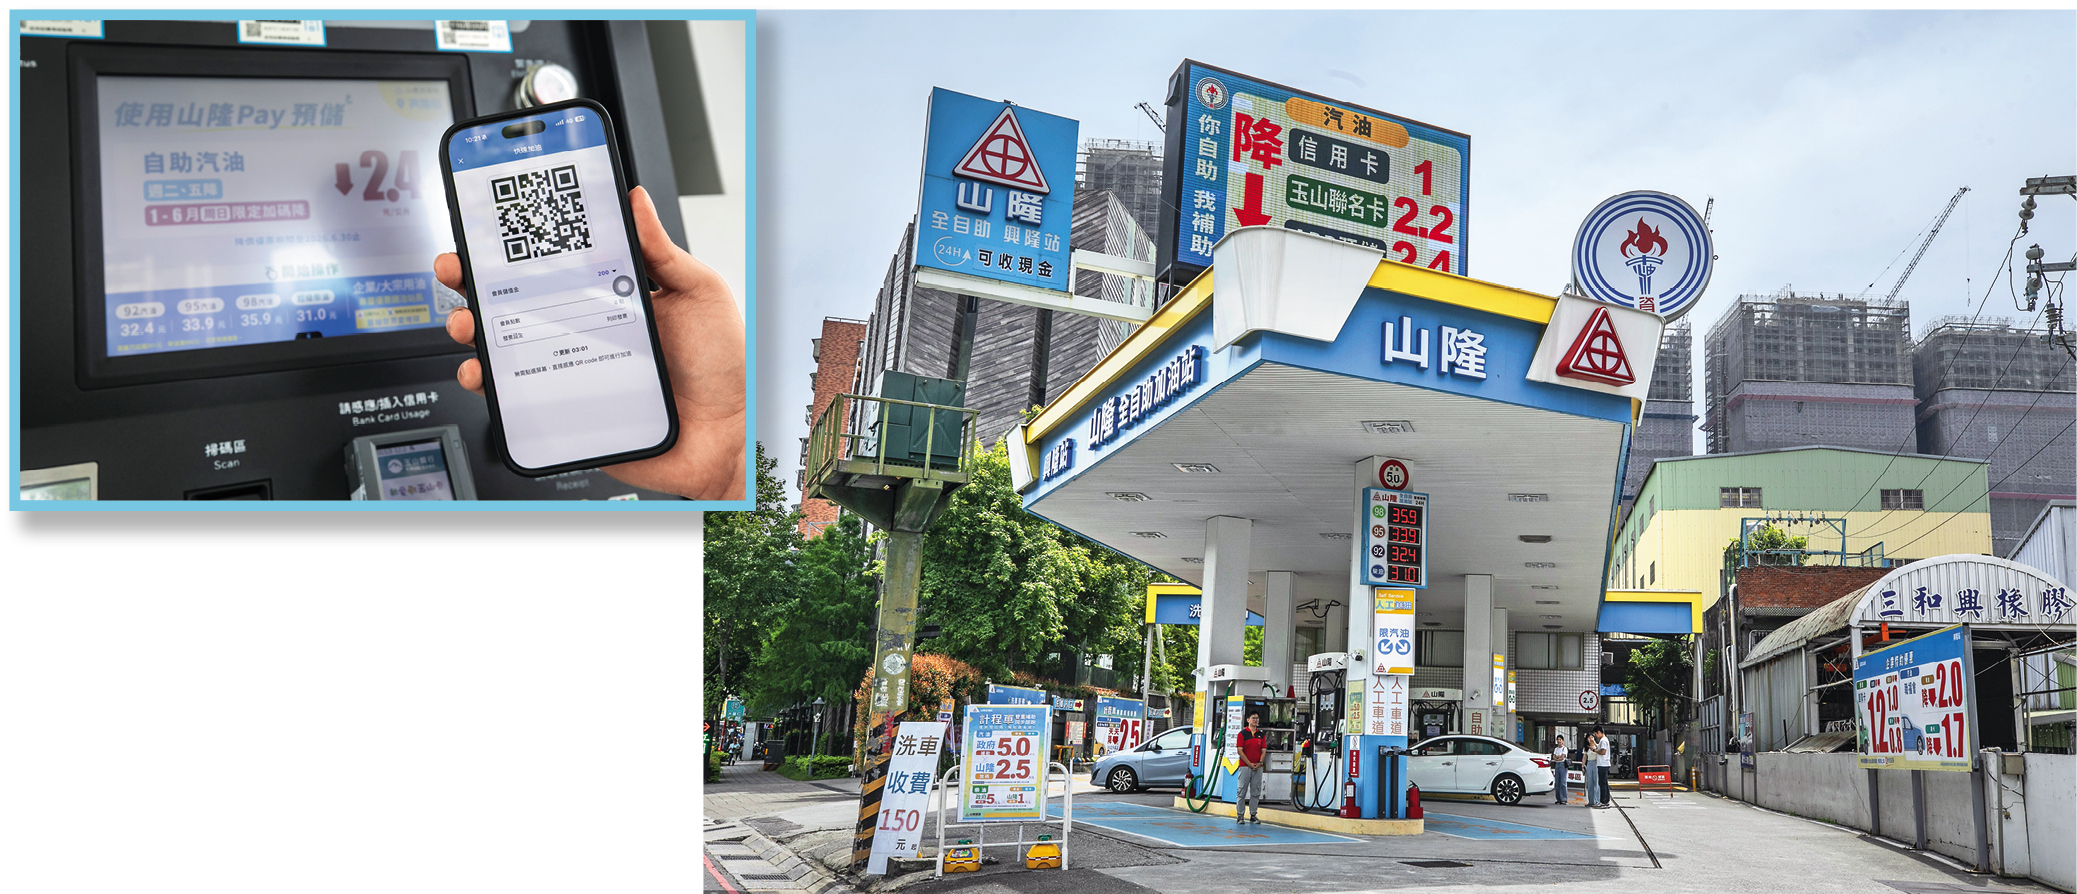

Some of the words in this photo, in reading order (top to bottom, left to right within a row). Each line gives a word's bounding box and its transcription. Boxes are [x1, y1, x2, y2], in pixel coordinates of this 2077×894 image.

[1324, 106, 1372, 138] 汽油
[465, 136, 481, 144] 10:21
[1195, 114, 1221, 182] 你自助
[1232, 112, 1284, 170] 降
[144, 151, 245, 174] 自助汽油
[1298, 134, 1379, 176] 信用卡
[1414, 159, 1432, 196] 1
[360, 150, 422, 202] 2.4
[148, 183, 218, 199] 週二、五降
[956, 181, 1044, 227] 山隆
[1289, 179, 1386, 222] 玉山聯名卡
[1392, 196, 1454, 245] 2.2
[931, 210, 990, 239] 全自助
[1004, 224, 1060, 252] 興隆站
[1190, 189, 1217, 258] 我補助
[938, 244, 962, 258] 24H
[978, 248, 1054, 279] 可收現金
[491, 286, 520, 297] 會員儲值金
[182, 317, 215, 332] 33.9
[217, 320, 226, 329] 元
[240, 312, 272, 327] 35.9
[296, 308, 326, 322] 31.0
[120, 322, 154, 337] 32.4
[158, 324, 167, 334] 元
[559, 348, 571, 356] 更新
[572, 346, 588, 354] 03:01
[1381, 315, 1488, 382] 山隆
[338, 391, 439, 415] 請感應/插入信用卡
[1042, 438, 1073, 482] 興隆站
[1088, 396, 1120, 451] 山隆
[1118, 344, 1203, 430] 全自助加油站
[352, 415, 376, 426] Bank
[378, 412, 400, 423] Card
[401, 408, 431, 420] Usage
[204, 440, 246, 458] 掃碼區
[214, 458, 241, 471] Scan
[1386, 472, 1400, 484] 5.0
[1382, 494, 1398, 502] 山隆
[1374, 507, 1385, 517] 98
[1392, 508, 1417, 525] 35.9
[1374, 527, 1384, 536] 95
[1392, 527, 1416, 544] 33.9
[1373, 546, 1384, 556] 92
[1392, 546, 1416, 562] 32.4
[1376, 600, 1412, 610] 人工加油
[1879, 586, 2072, 623] 三和興橡膠
[1379, 628, 1410, 638] 限汽油
[1936, 660, 1964, 708] 2.0
[1372, 676, 1385, 735] 人工車道
[1390, 676, 1403, 735] 人工車道
[1886, 685, 1899, 712] 1.0
[980, 714, 1014, 725] 計程車
[1470, 712, 1482, 735] 自助
[1868, 689, 1889, 753] 1.2
[895, 734, 940, 758] 洗車
[976, 740, 996, 750] 政府
[997, 737, 1030, 756] 5.0
[1888, 727, 1903, 754] 0.8
[1941, 712, 1964, 758] 1.7
[976, 762, 995, 772] 山隆
[995, 759, 1030, 780] 2.5
[887, 771, 932, 796] 收費
[986, 794, 995, 804] 5
[1018, 794, 1024, 804] 1
[878, 808, 920, 832] 150
[896, 838, 906, 850] 元
